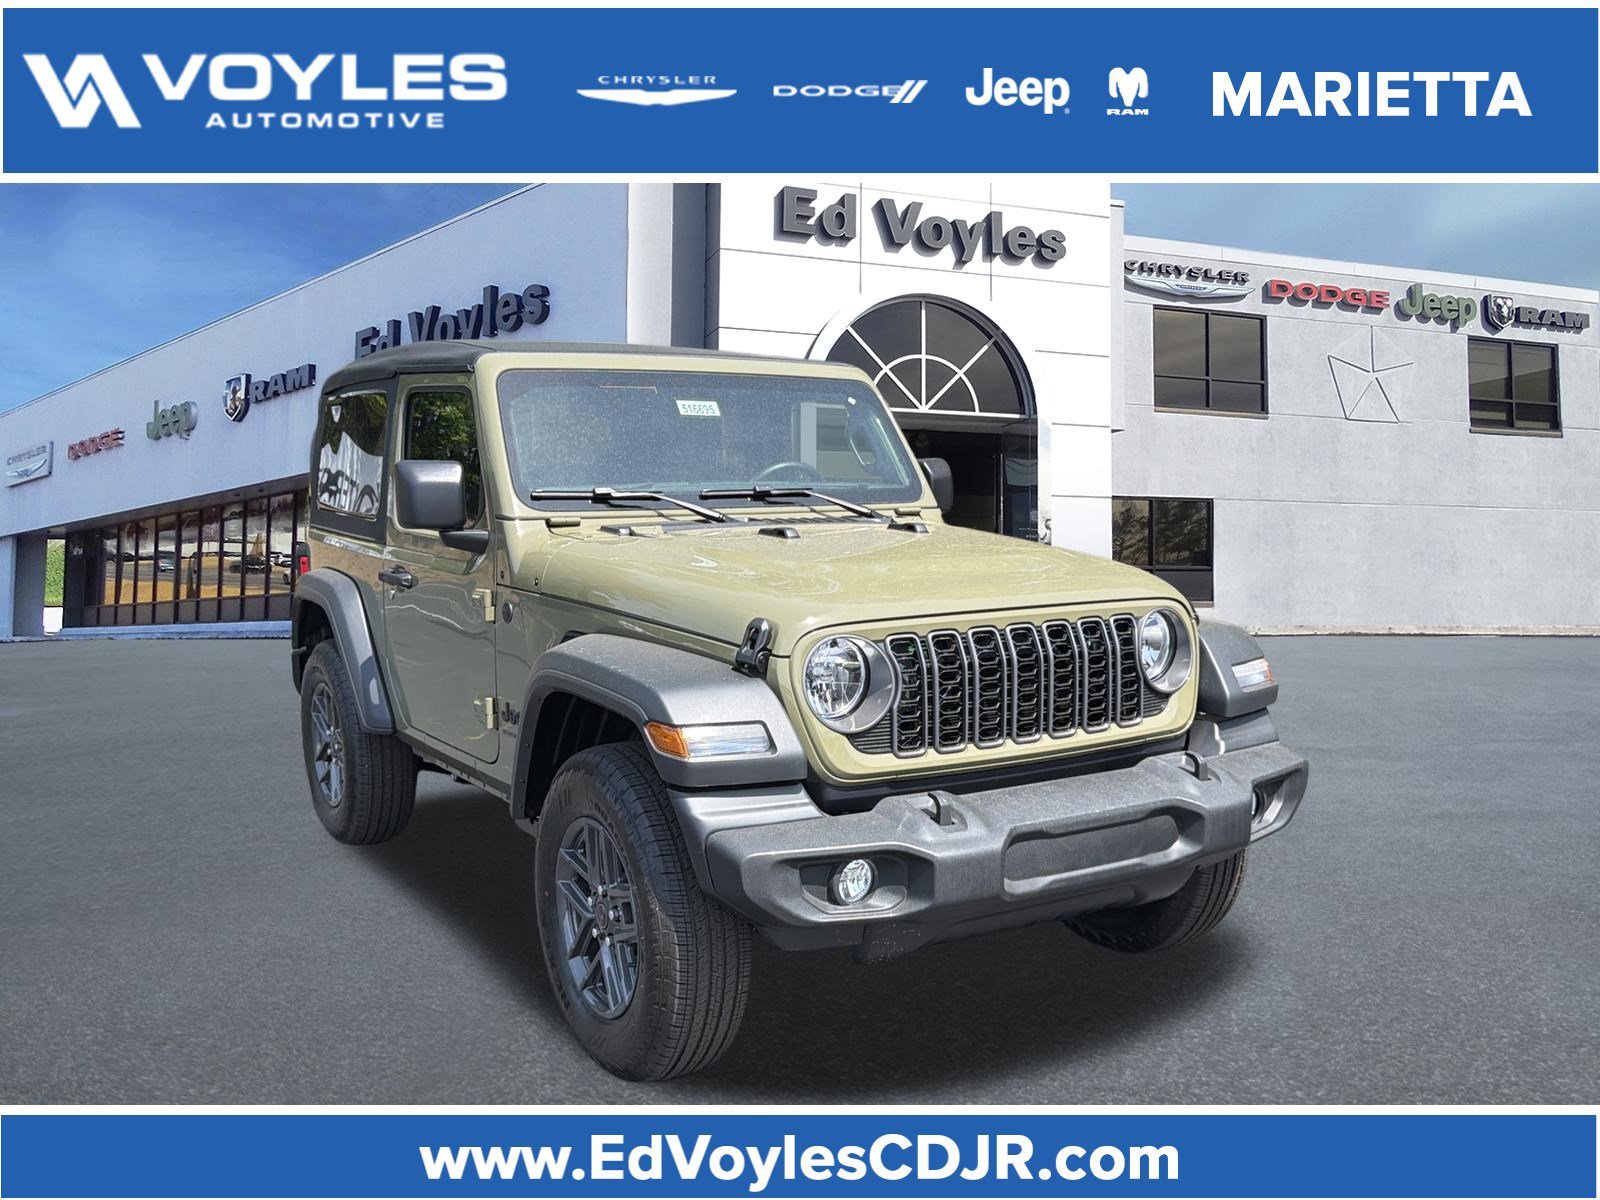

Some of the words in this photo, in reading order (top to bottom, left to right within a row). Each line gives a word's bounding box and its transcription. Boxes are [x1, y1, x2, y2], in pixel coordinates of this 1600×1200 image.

[774, 186, 856, 247] Ed
[872, 198, 1066, 270] Voyles
[1124, 259, 1251, 286] CHRYSLER
[1262, 279, 1390, 315] DODGE
[1394, 283, 1477, 333] Jeep
[355, 319, 401, 359] Ed
[408, 284, 550, 341] Voyles
[1512, 306, 1590, 334] RAM
[250, 363, 316, 404] RAM
